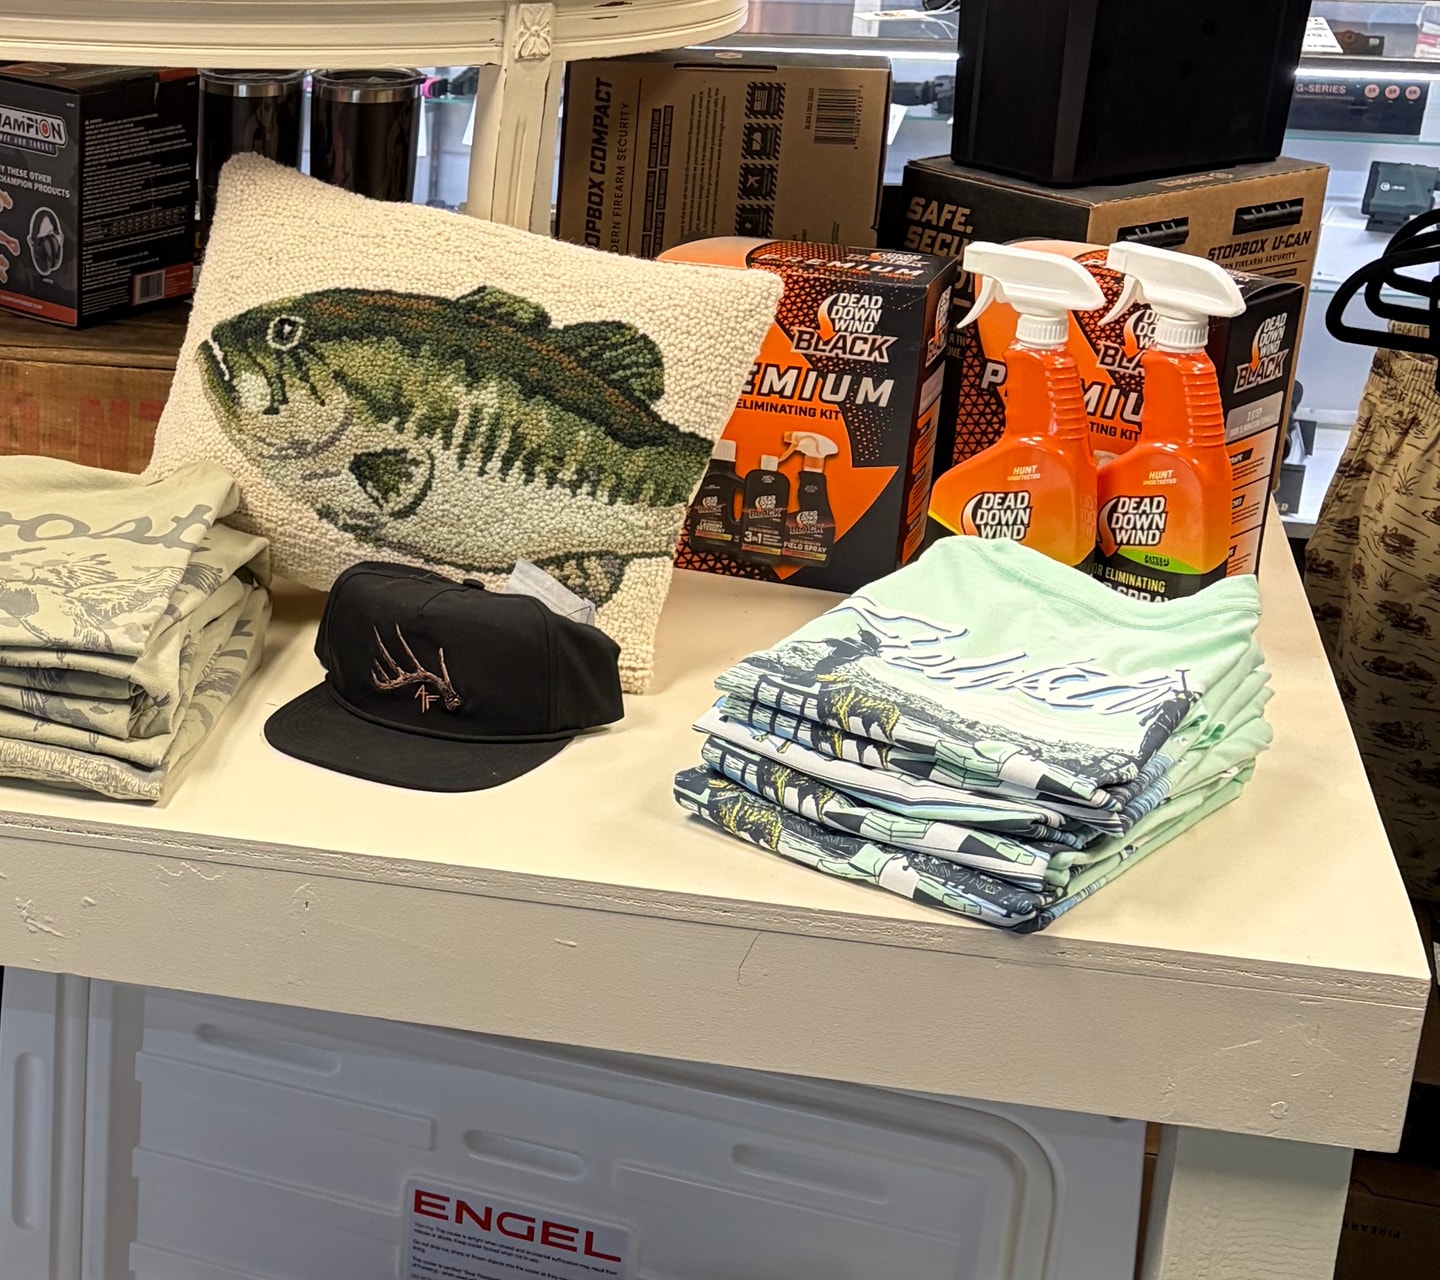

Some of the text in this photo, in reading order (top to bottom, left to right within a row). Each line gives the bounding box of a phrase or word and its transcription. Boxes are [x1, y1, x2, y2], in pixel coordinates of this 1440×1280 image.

[584, 76, 612, 249] OPBOX COMPACT
[613, 102, 631, 226] FIREARM SECURITY
[7, 166, 28, 177] THESE
[30, 171, 52, 184] OTHER
[34, 183, 70, 198] PRODUCTS
[907, 197, 974, 234] SAFE.
[904, 225, 972, 260] SECU
[1208, 230, 1312, 261] STOPBOX U-CAN
[1235, 252, 1297, 269] FIREARM SECURITY
[838, 293, 883, 308] DEAD
[831, 306, 882, 321] DOWN
[1263, 312, 1288, 331] DEAD
[835, 319, 875, 333] WIND
[793, 329, 895, 361] BLACK
[1260, 327, 1285, 346] DOWN
[1260, 340, 1281, 357] WIND
[1100, 350, 1144, 372] BLA
[1236, 351, 1286, 391] BLACK
[742, 363, 895, 407] EMIUM
[736, 399, 842, 420] ELIMINATING KIT
[1013, 465, 1038, 475] HUNT
[1148, 470, 1174, 480] HUNT
[982, 492, 1030, 509] DEAD
[1117, 497, 1166, 513] DEAD
[976, 508, 1030, 525] DOWN
[1111, 513, 1167, 530] DOWN
[980, 525, 1027, 540] WIND
[1115, 530, 1161, 545] WIND
[784, 541, 827, 553] FIELD SPRAY
[1105, 567, 1166, 593] ELIMINATING
[413, 1189, 622, 1263] ENGEL
